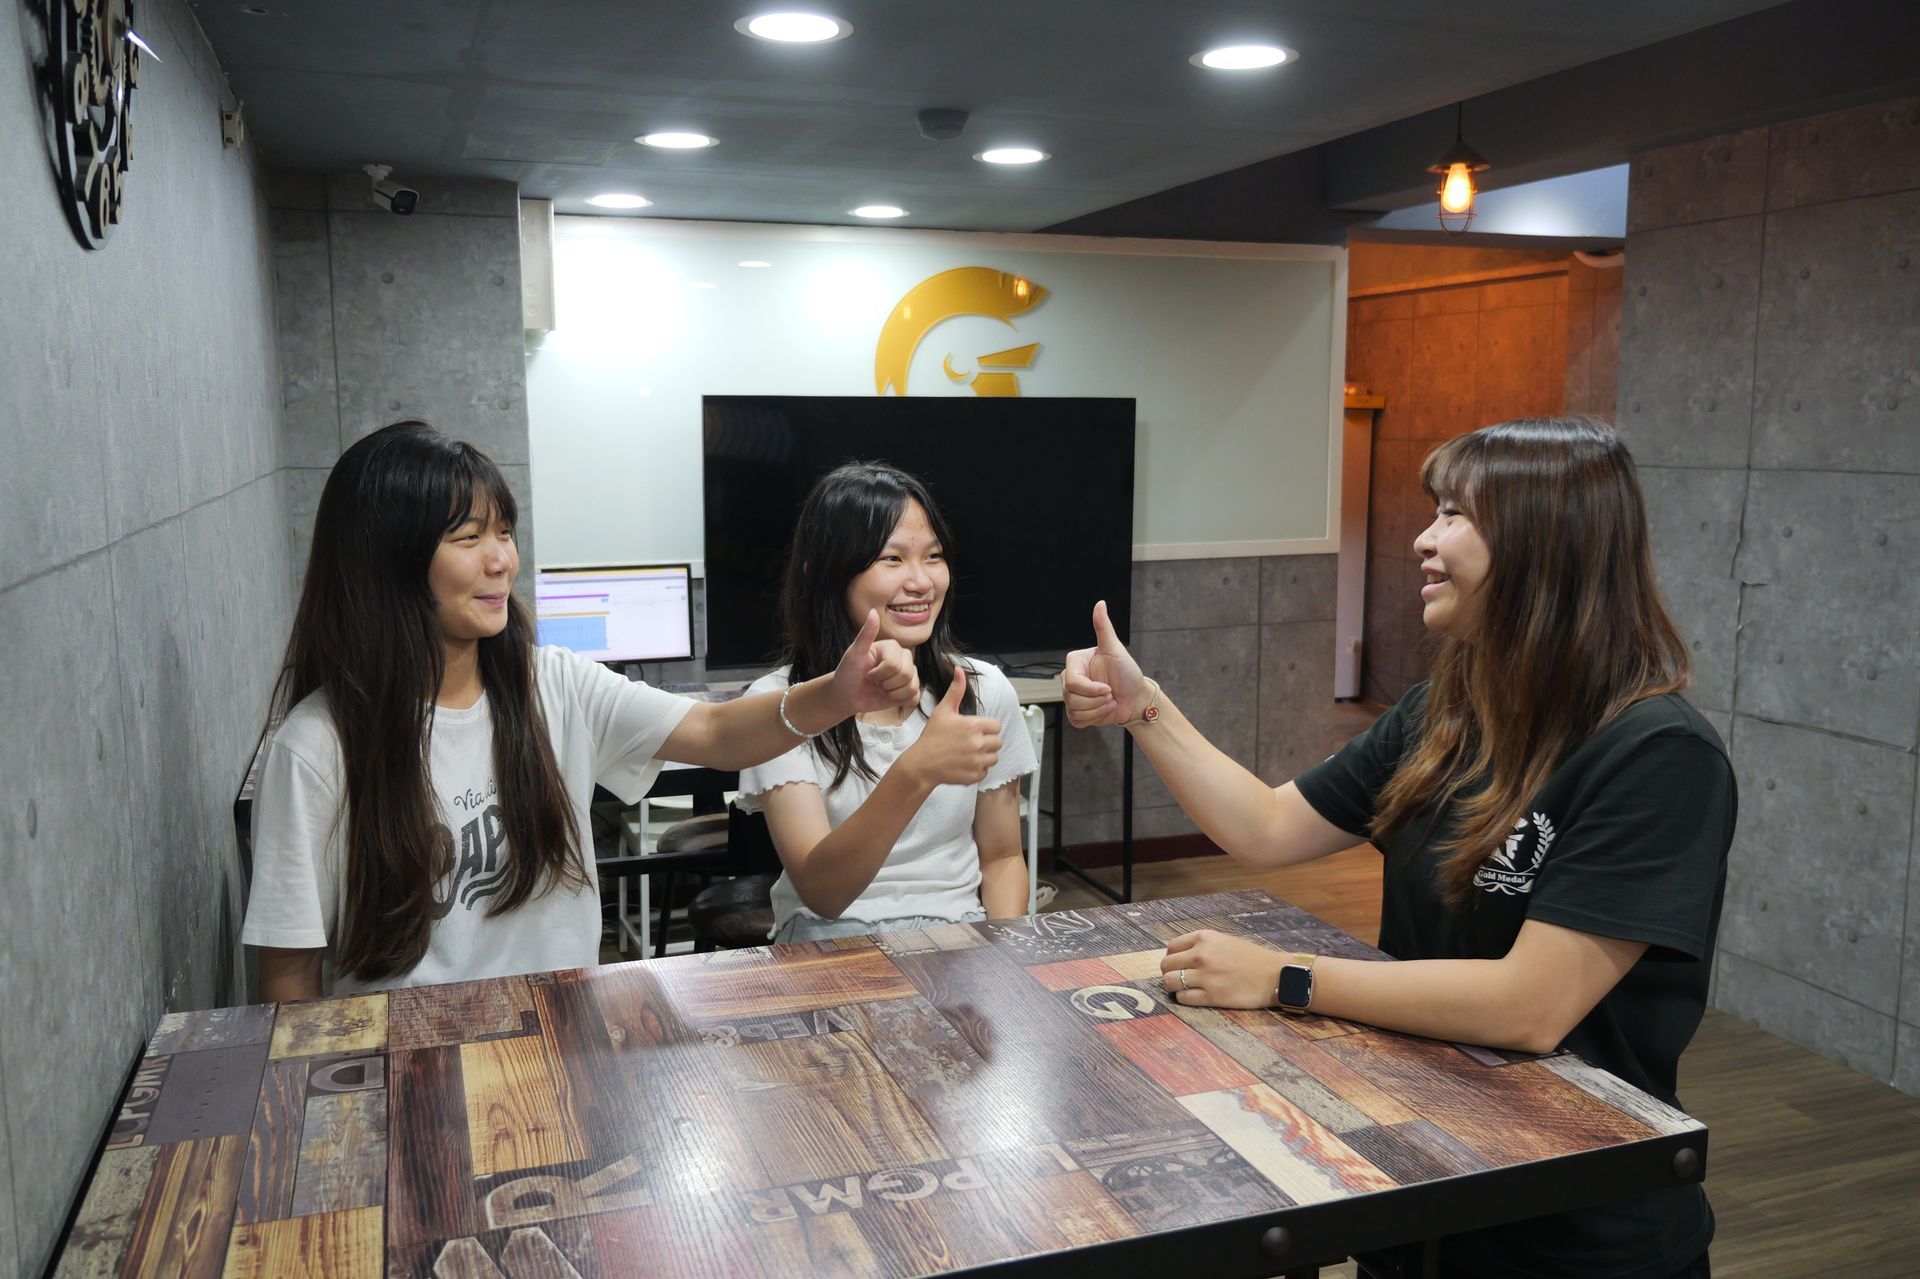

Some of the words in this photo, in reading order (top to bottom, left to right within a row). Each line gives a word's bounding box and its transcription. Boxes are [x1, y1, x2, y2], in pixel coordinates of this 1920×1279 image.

[454, 788, 485, 811] Via
[1477, 870, 1496, 880] Gold
[1497, 873, 1526, 884] Medal
[310, 1055, 385, 1092] D
